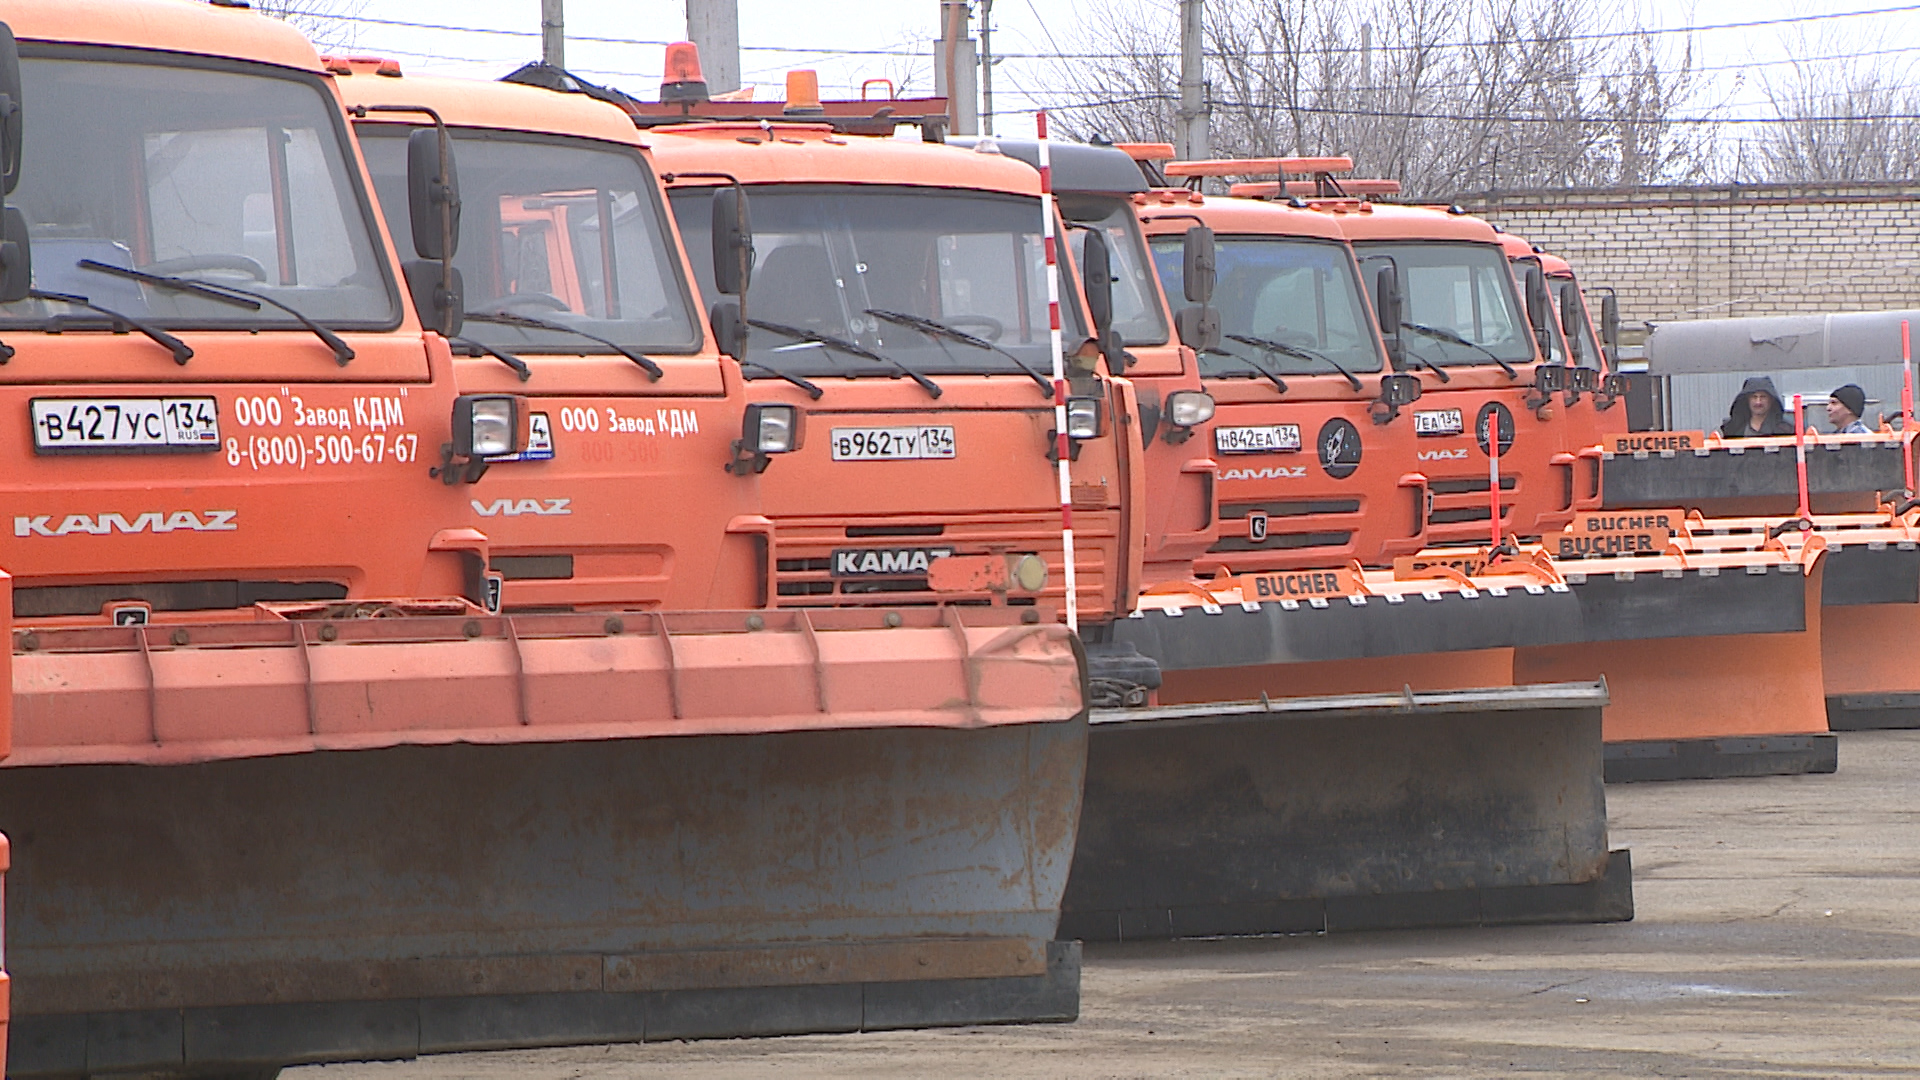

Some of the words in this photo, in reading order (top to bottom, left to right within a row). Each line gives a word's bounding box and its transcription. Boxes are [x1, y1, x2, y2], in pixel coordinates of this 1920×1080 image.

[166, 401, 212, 429] 134
[234, 396, 282, 427] ООО
[560, 406, 600, 432] ООО
[606, 407, 656, 436] Завод
[656, 408, 699, 438] КДМ
[921, 428, 953, 447] 134
[1616, 435, 1692, 451] BUCHER
[226, 433, 419, 470] 8-(800)-500-67-67
[14, 509, 238, 537] KAMAZ
[1587, 515, 1670, 532] BUCHER
[1559, 535, 1653, 555] BUCHER
[1255, 572, 1341, 598] BUCHER
